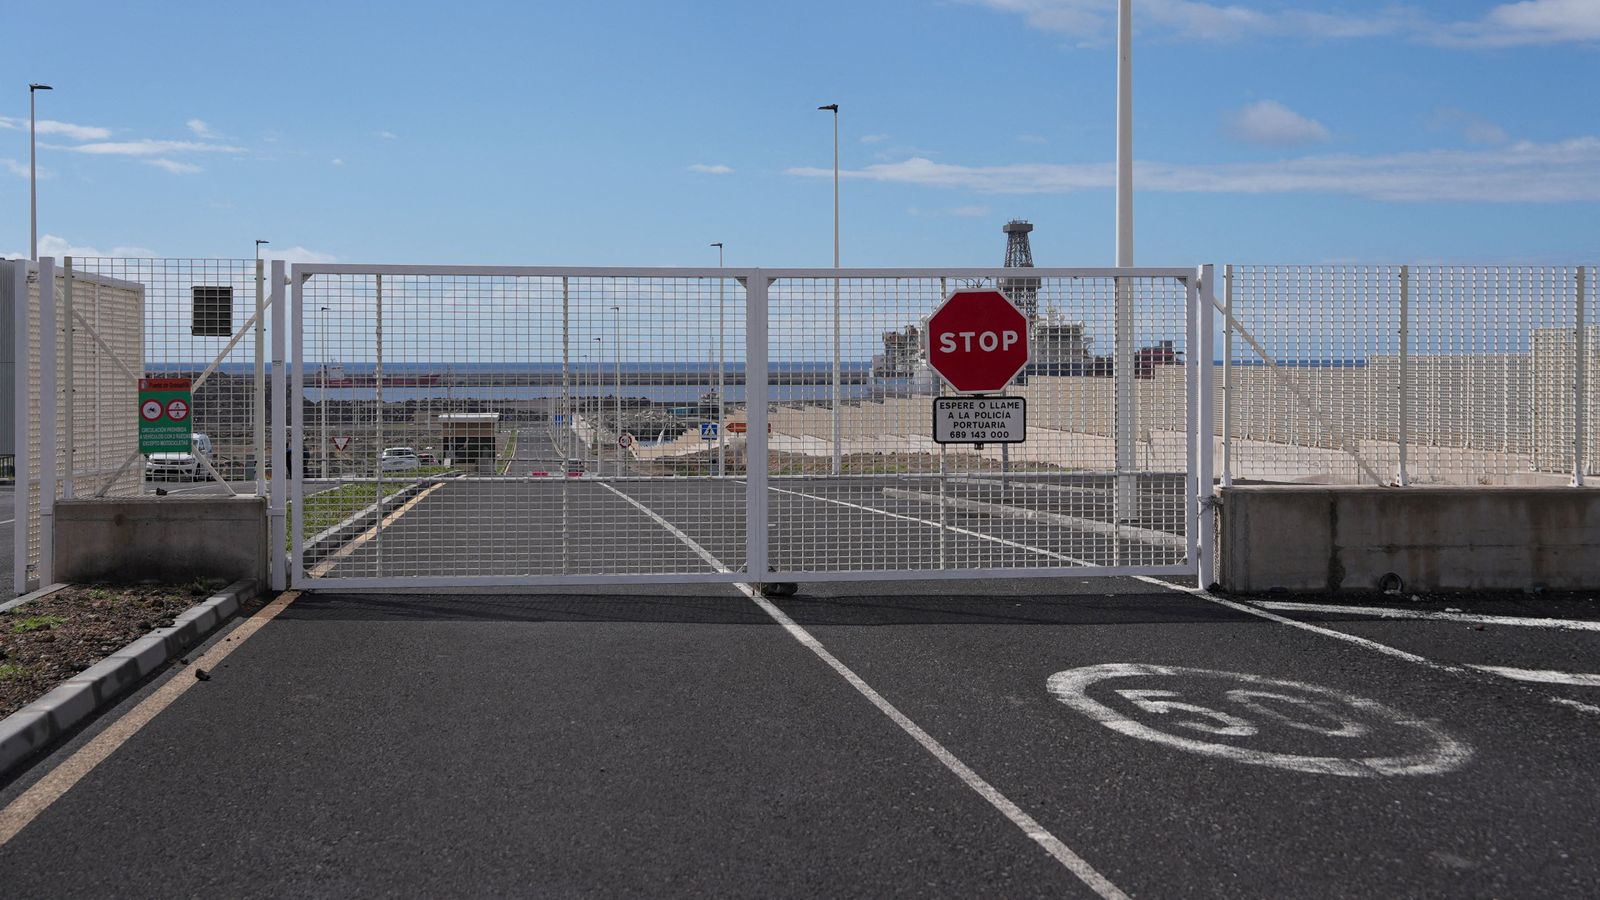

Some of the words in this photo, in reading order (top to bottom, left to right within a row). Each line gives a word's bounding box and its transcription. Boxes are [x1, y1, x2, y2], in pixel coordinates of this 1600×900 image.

[939, 331, 1018, 353] STOP
[958, 411, 970, 419] LA
[974, 410, 1011, 419] POLICÍA
[953, 421, 1006, 429] PORTUARIA
[950, 431, 967, 439] 689
[971, 431, 986, 439] 143
[990, 431, 1009, 439] 000
